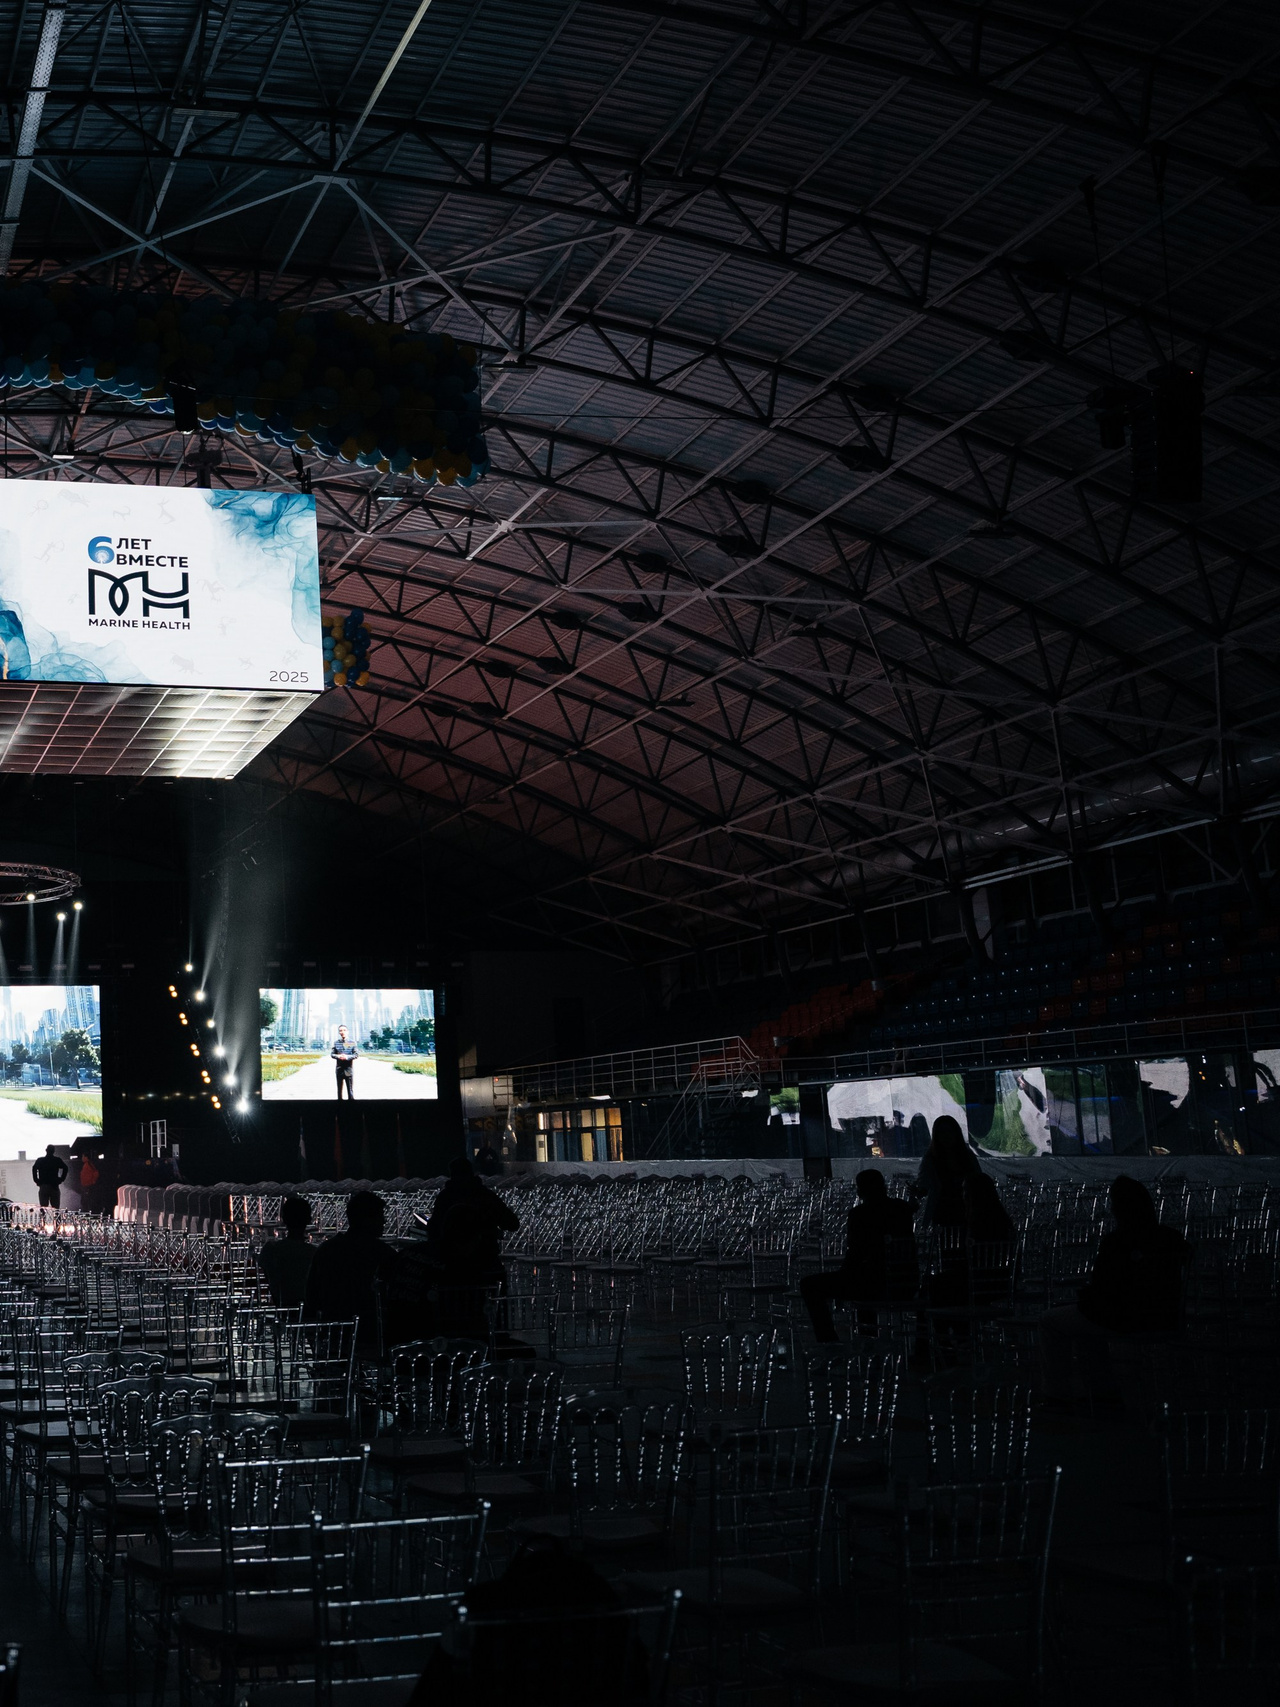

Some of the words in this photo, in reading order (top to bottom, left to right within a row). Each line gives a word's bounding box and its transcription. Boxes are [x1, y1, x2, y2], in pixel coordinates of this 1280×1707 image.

[87, 535, 115, 564] 6
[116, 537, 152, 550] ЛЕТ
[116, 553, 189, 568] ВМЕСТЕ
[88, 618, 139, 628] MARINE
[142, 620, 191, 630] HEALTH
[269, 670, 309, 683] 2025
